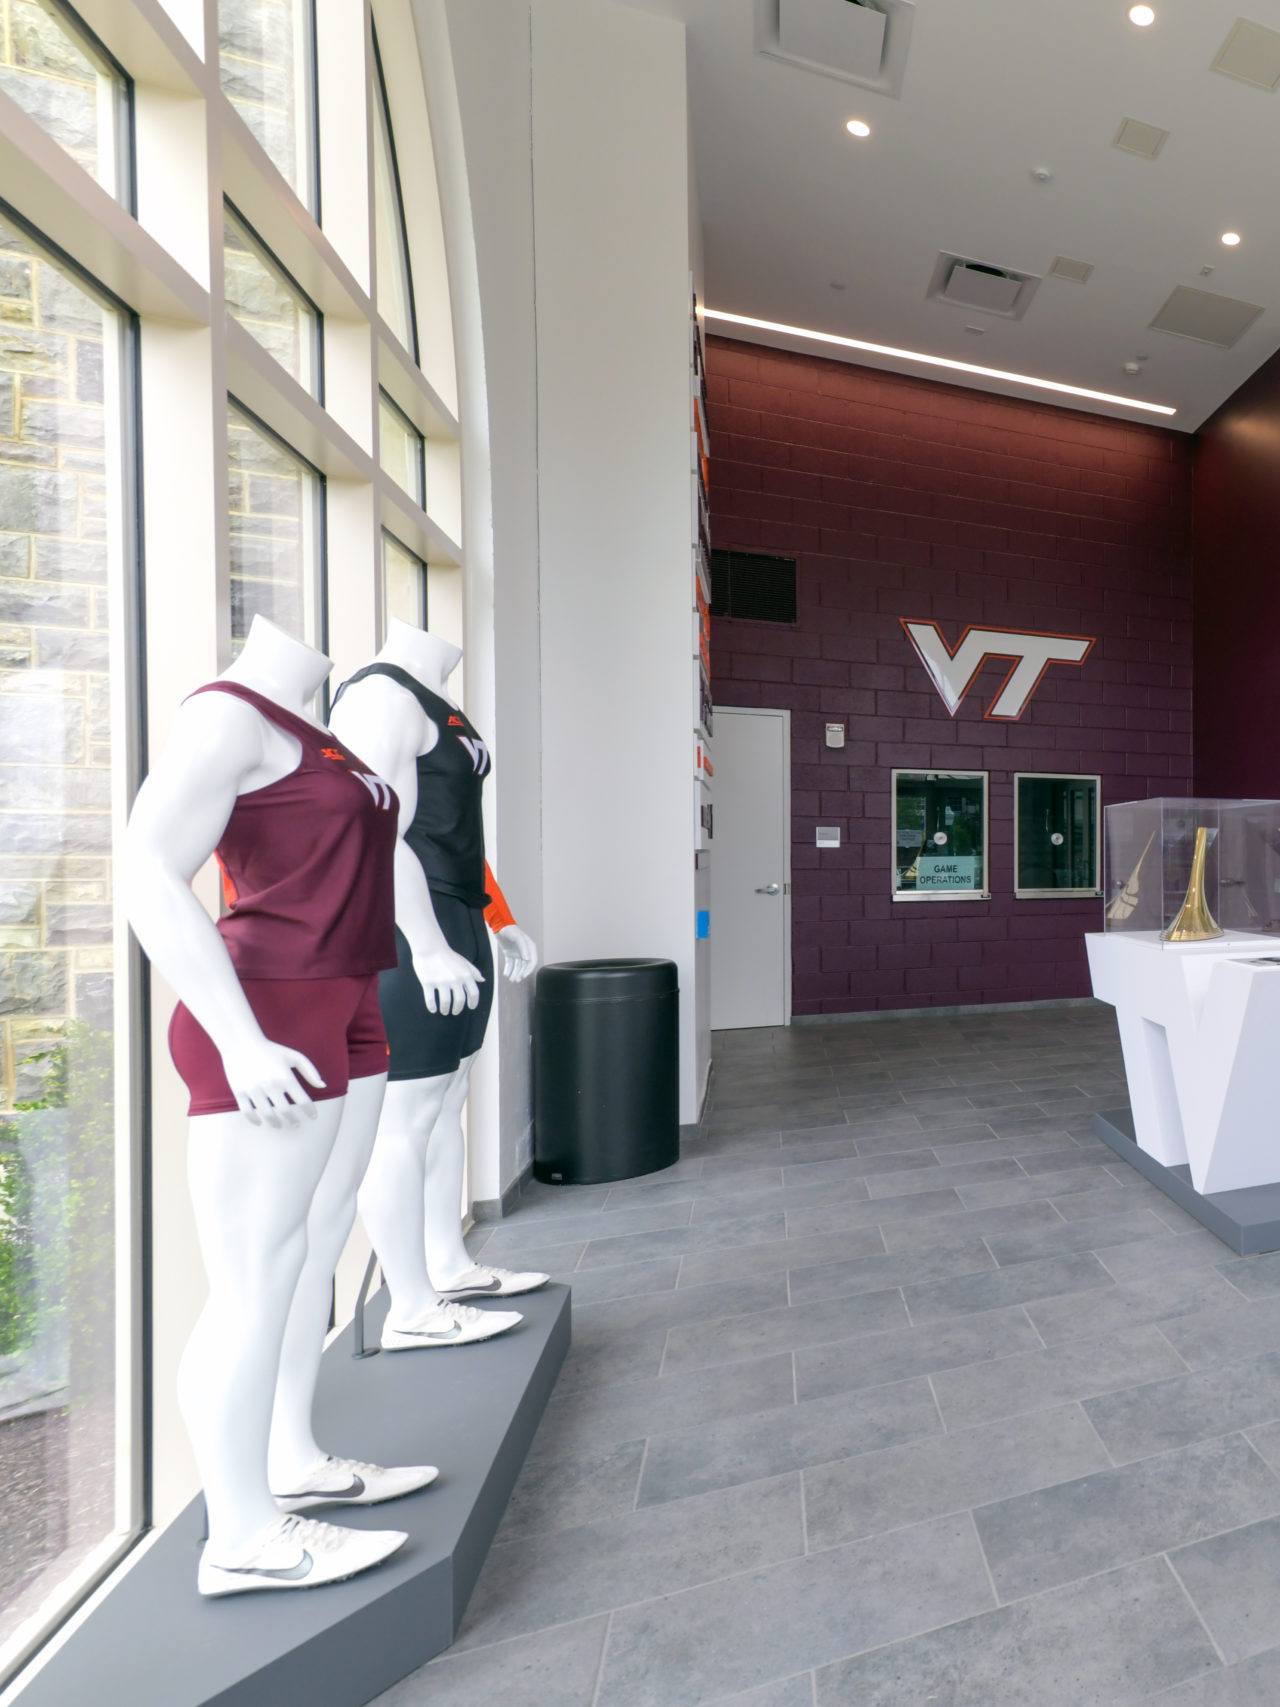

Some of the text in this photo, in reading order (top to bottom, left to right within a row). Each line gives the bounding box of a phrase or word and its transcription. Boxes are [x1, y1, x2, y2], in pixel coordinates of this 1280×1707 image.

[899, 617, 1097, 721] VT
[933, 864, 958, 874] GAME
[919, 875, 972, 885] OPERATIONS
